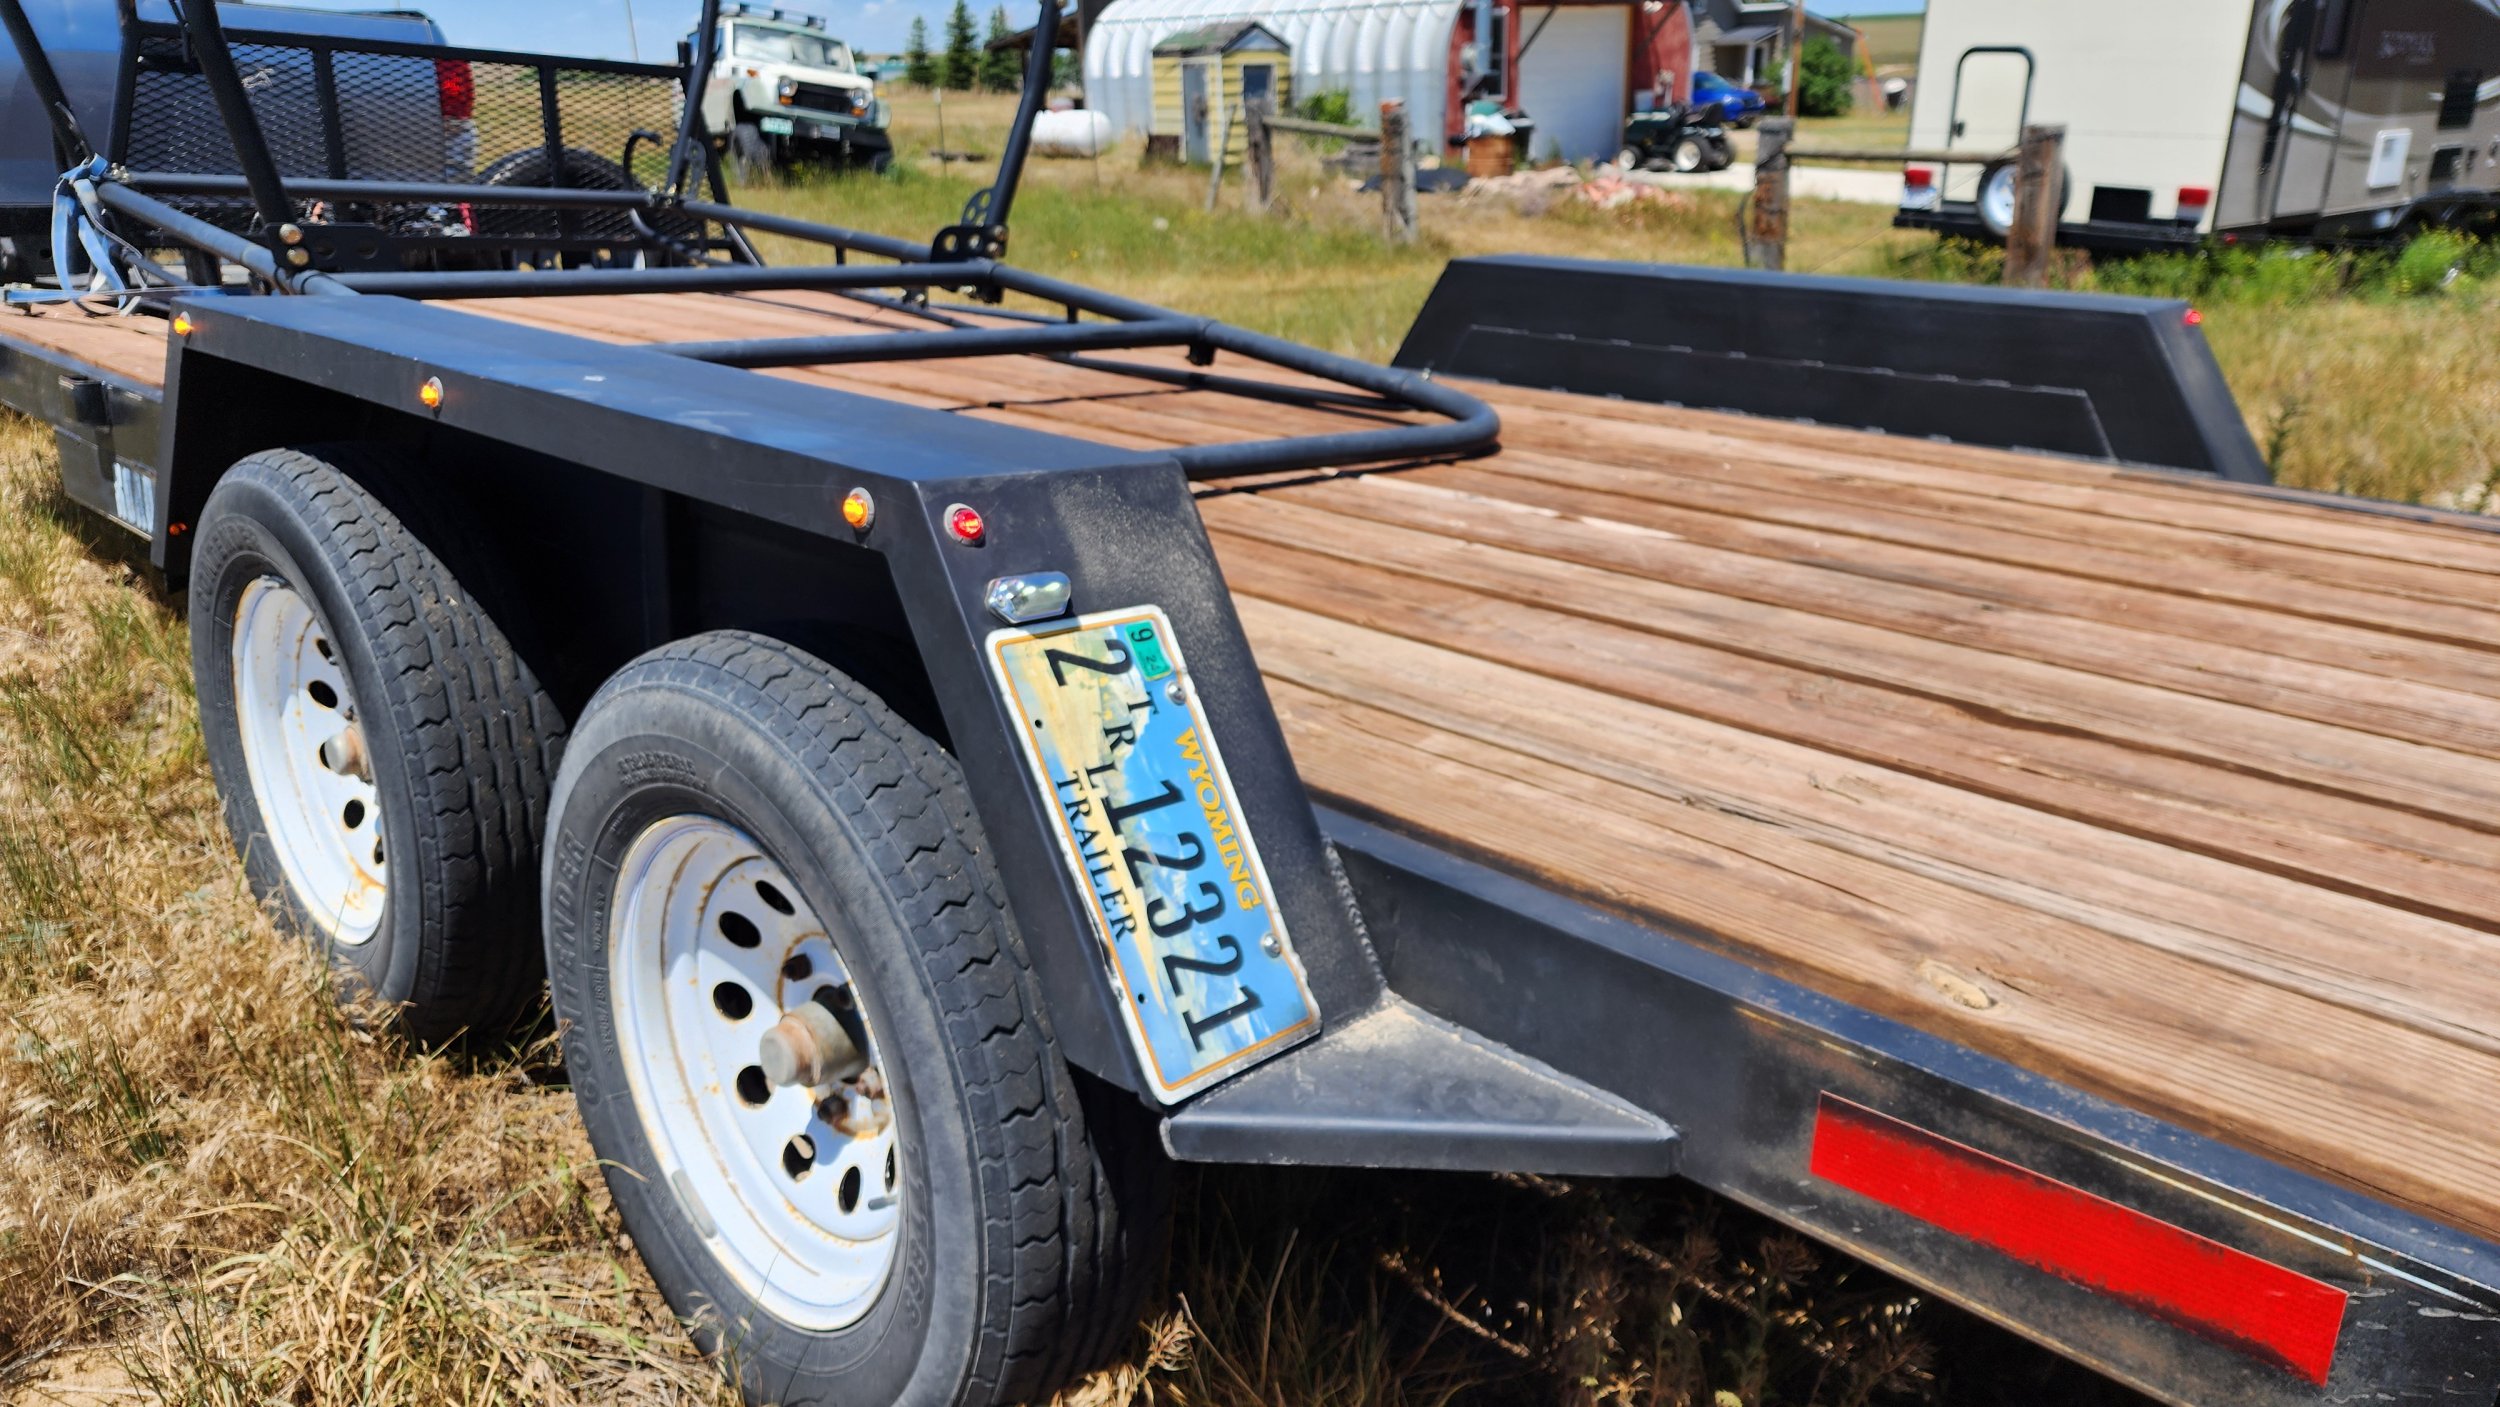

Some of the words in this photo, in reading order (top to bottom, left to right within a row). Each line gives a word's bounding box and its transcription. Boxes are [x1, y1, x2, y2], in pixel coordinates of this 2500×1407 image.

[1044, 638, 1134, 688] 2
[1130, 627, 1156, 643] 9
[1085, 690, 1161, 789] TRL
[1055, 769, 1139, 943] TRAILER
[1174, 726, 1263, 912] WYOMING
[1102, 779, 1265, 1053] 12321
